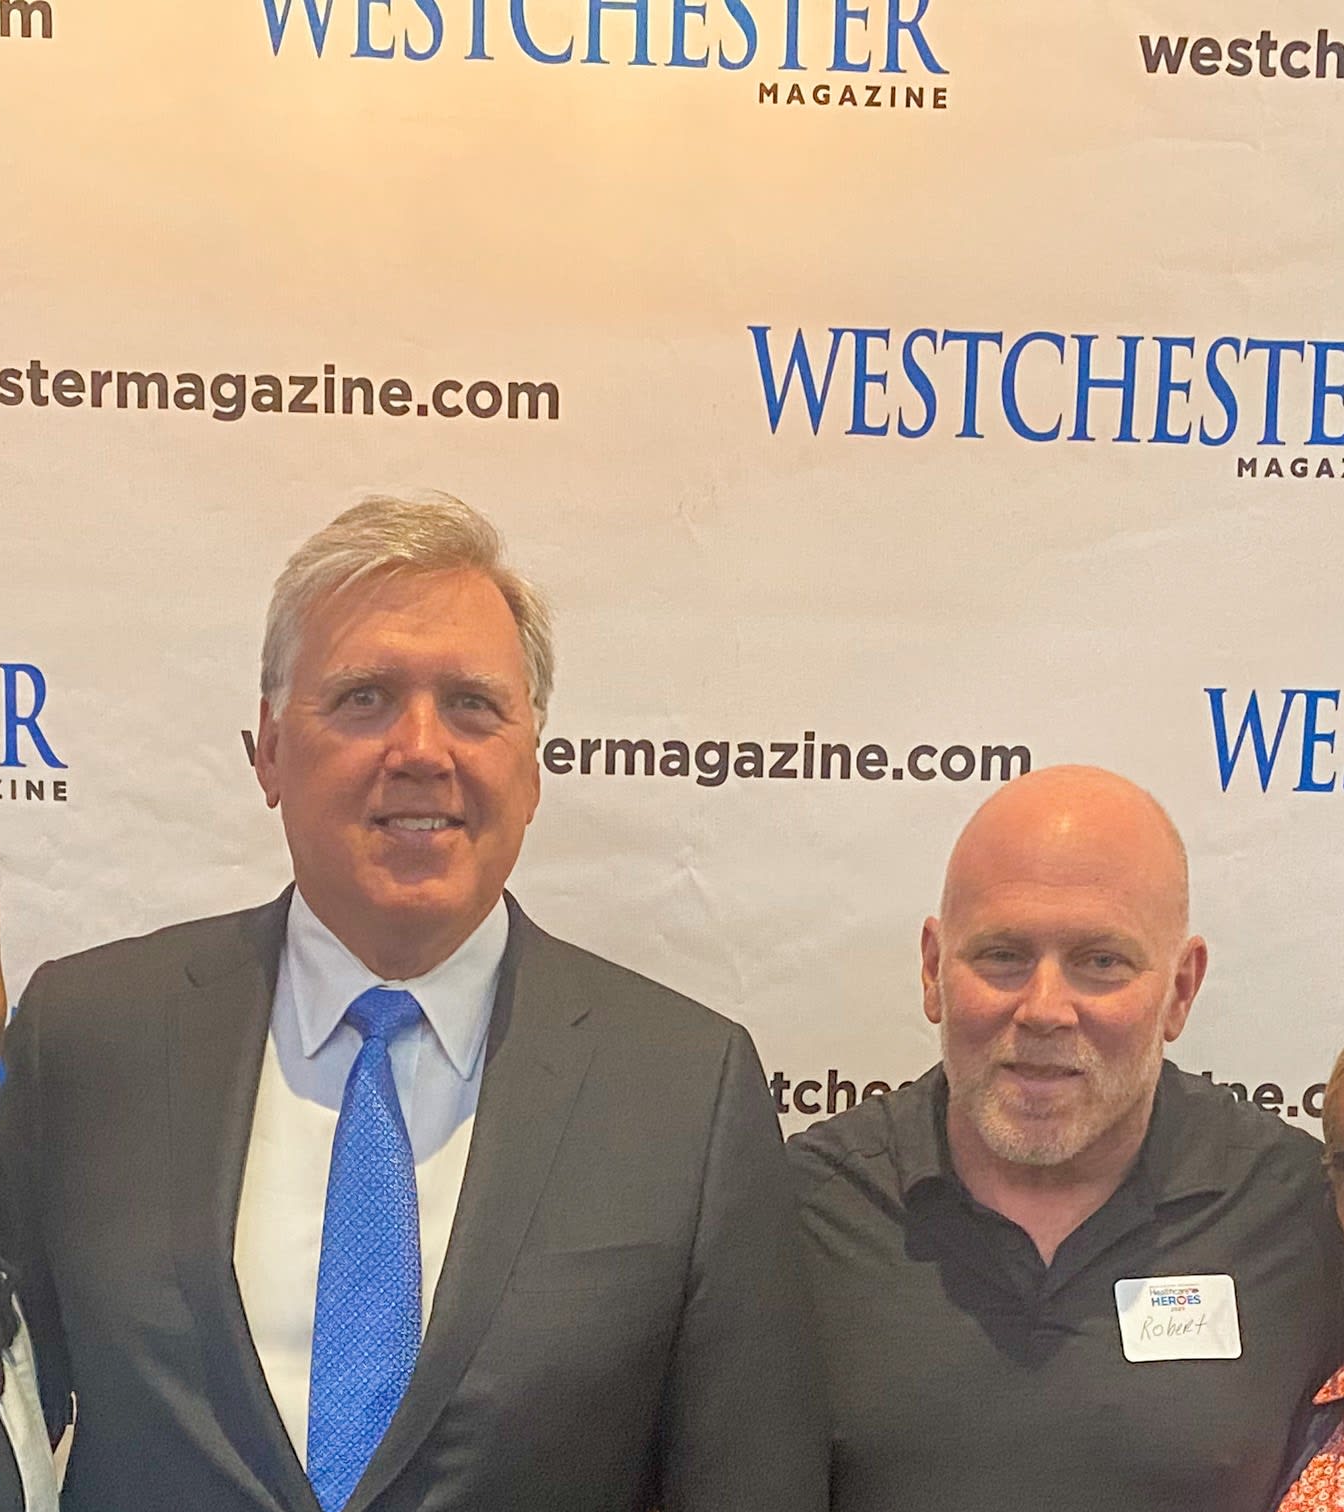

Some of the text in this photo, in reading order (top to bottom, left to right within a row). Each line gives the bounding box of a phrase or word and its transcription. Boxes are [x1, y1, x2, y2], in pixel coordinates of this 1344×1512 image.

[264, 0, 950, 75] WESTCHESTER
[760, 84, 947, 109] MAGAZINE
[543, 732, 1032, 788] ermagazine.com
[1151, 1295, 1202, 1306] HEROES
[1140, 1313, 1208, 1342] Robert
